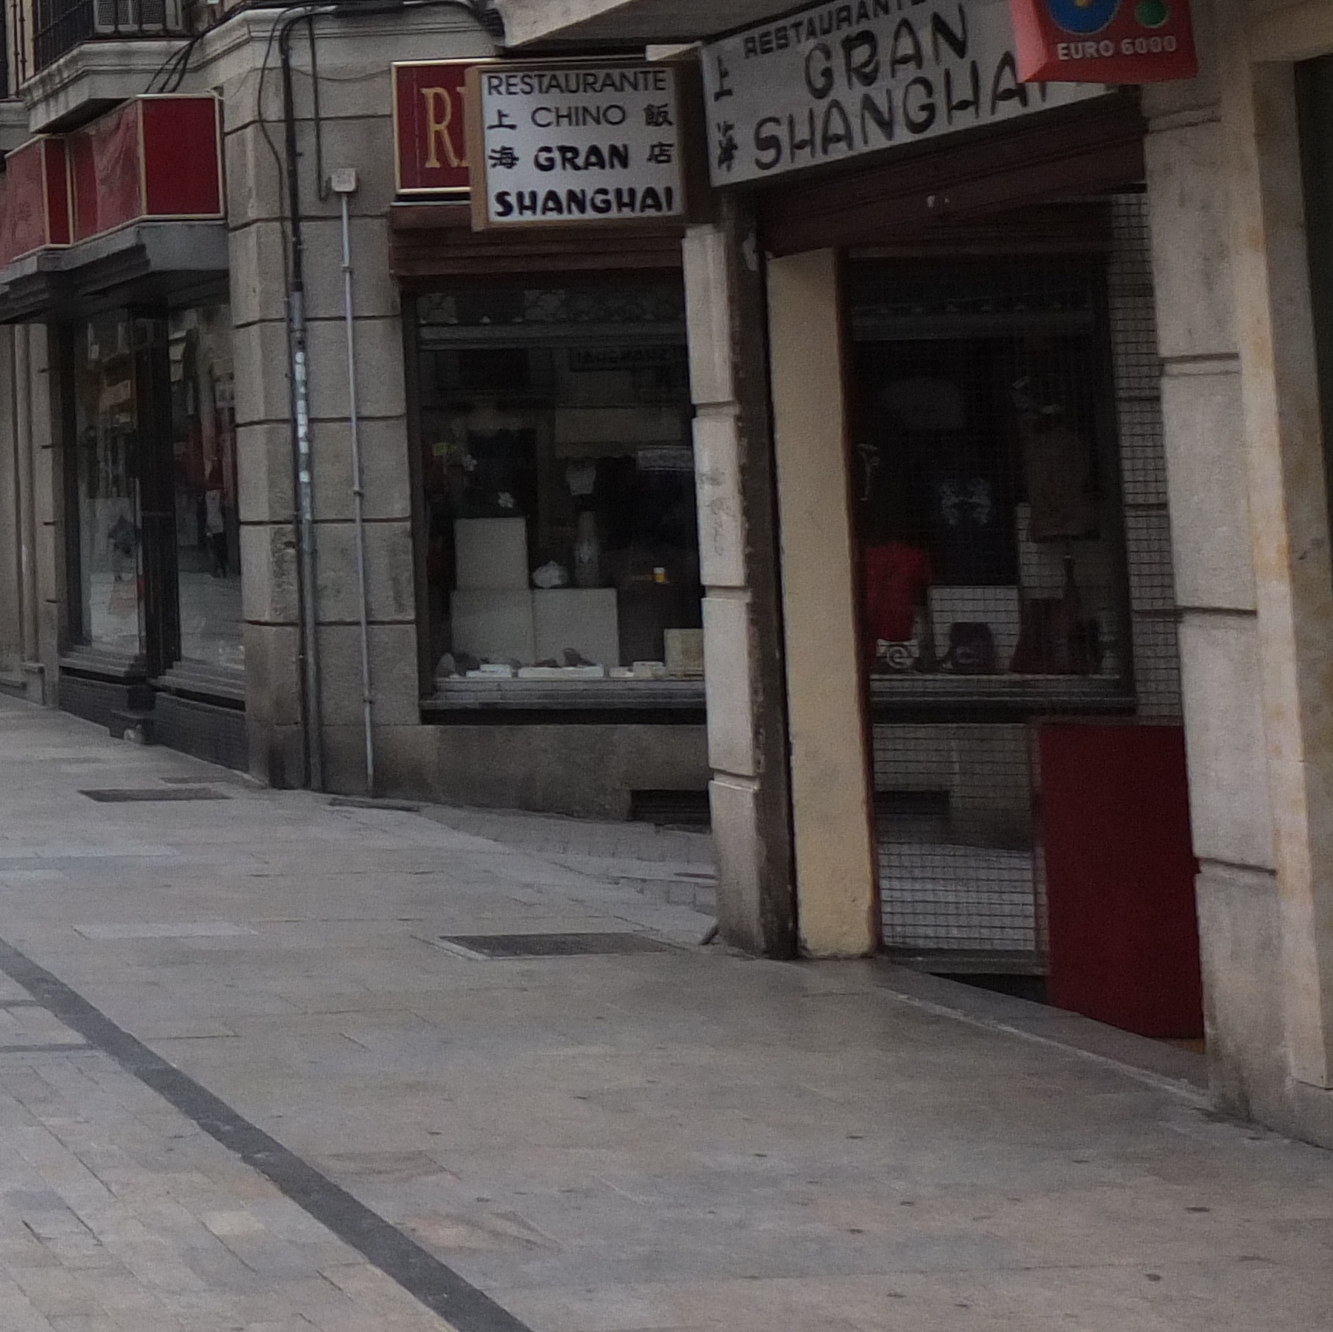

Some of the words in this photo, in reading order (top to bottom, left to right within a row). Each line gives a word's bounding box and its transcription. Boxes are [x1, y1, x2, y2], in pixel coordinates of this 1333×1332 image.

[804, 3, 969, 99] GRAN
[1057, 39, 1115, 61] EURO
[1120, 35, 1177, 56] 6000
[487, 70, 667, 96] RESTAURANTE
[420, 86, 470, 168] R
[530, 104, 626, 128] CHINO
[534, 144, 630, 172] GRAN
[494, 186, 674, 217] SHANGHAI
